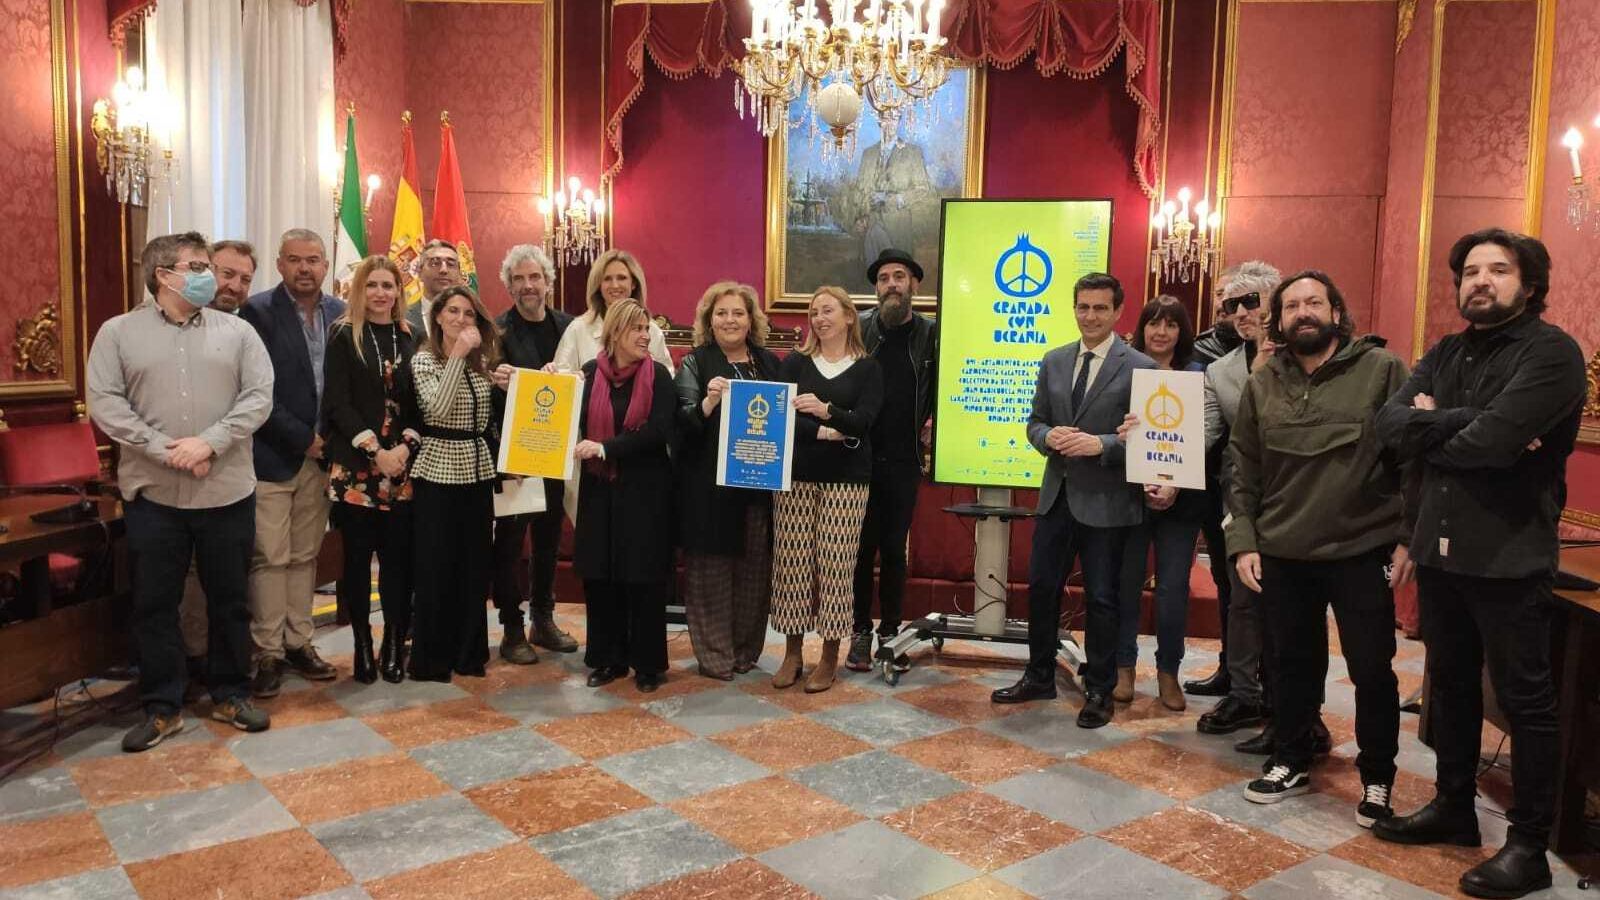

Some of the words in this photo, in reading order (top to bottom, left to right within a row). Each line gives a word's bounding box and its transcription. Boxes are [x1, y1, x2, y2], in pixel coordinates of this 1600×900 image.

[993, 301, 1050, 315] GRANADA
[994, 330, 1047, 344] UCRANIA
[1145, 430, 1184, 443] GRANADA
[1146, 451, 1183, 464] UCRANIA
